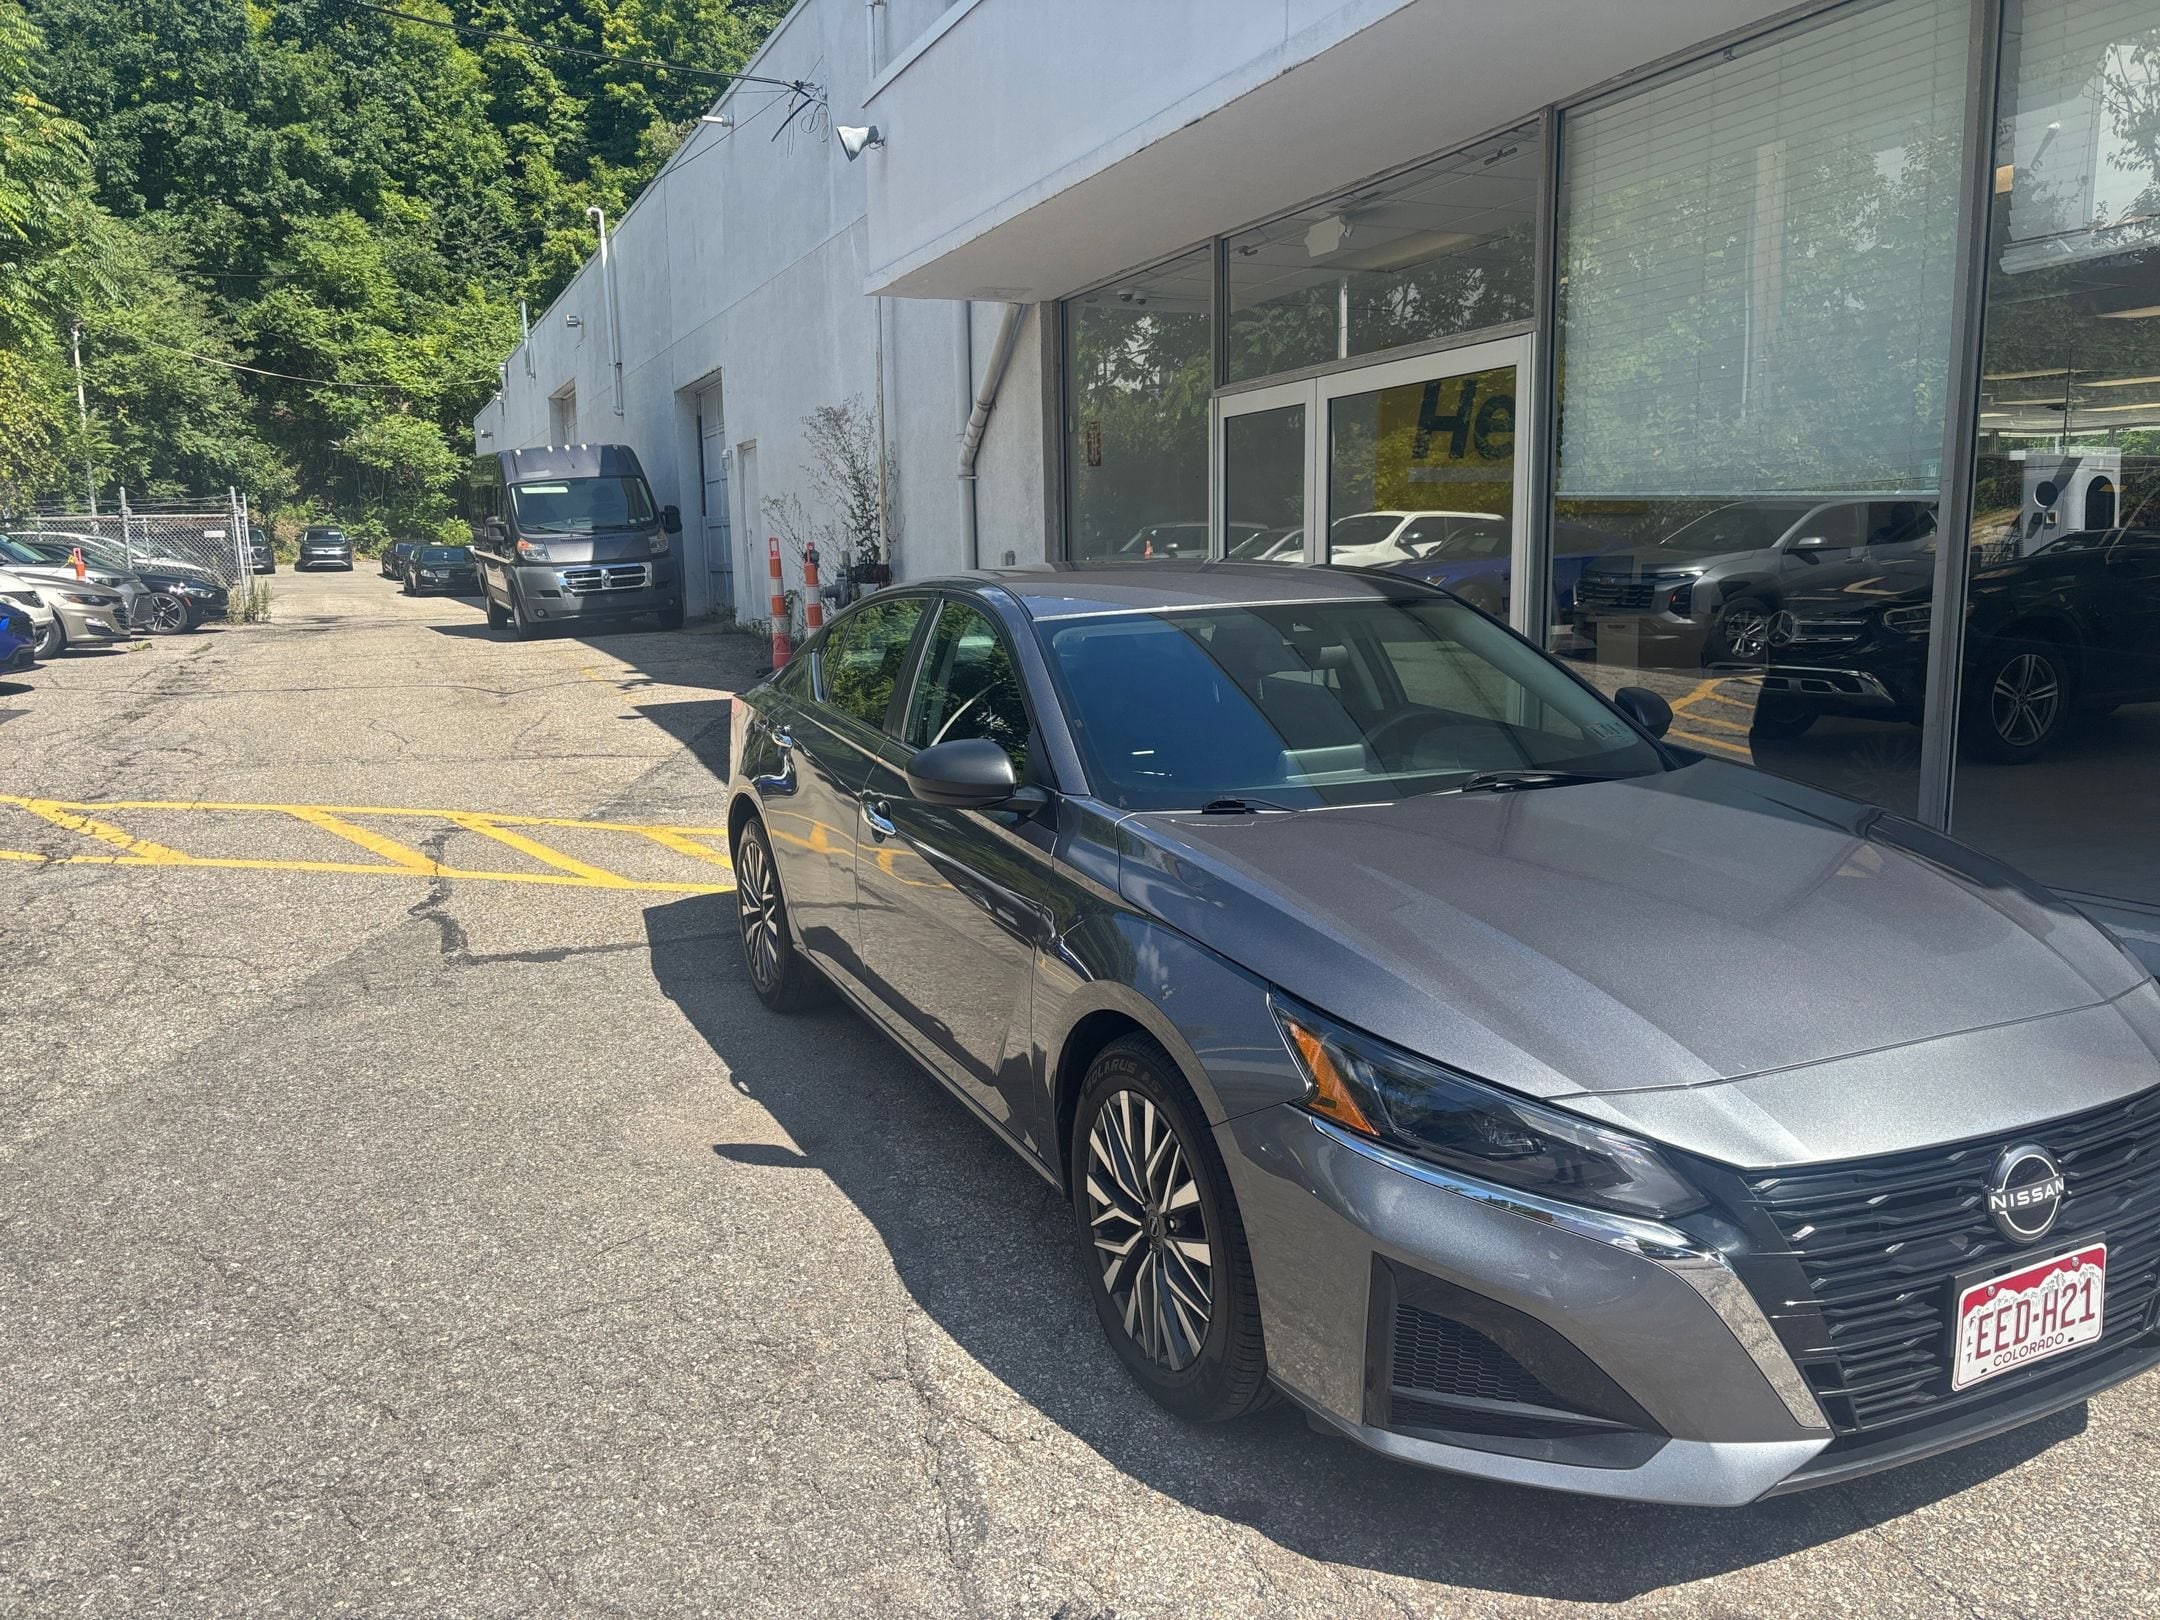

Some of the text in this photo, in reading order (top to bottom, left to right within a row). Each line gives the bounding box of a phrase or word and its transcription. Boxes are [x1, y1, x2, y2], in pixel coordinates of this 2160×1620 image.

[1990, 1177, 2065, 1210] NISSAN
[1975, 1277, 2096, 1360] EED-H21
[1993, 1332, 2065, 1367] COLORADO
